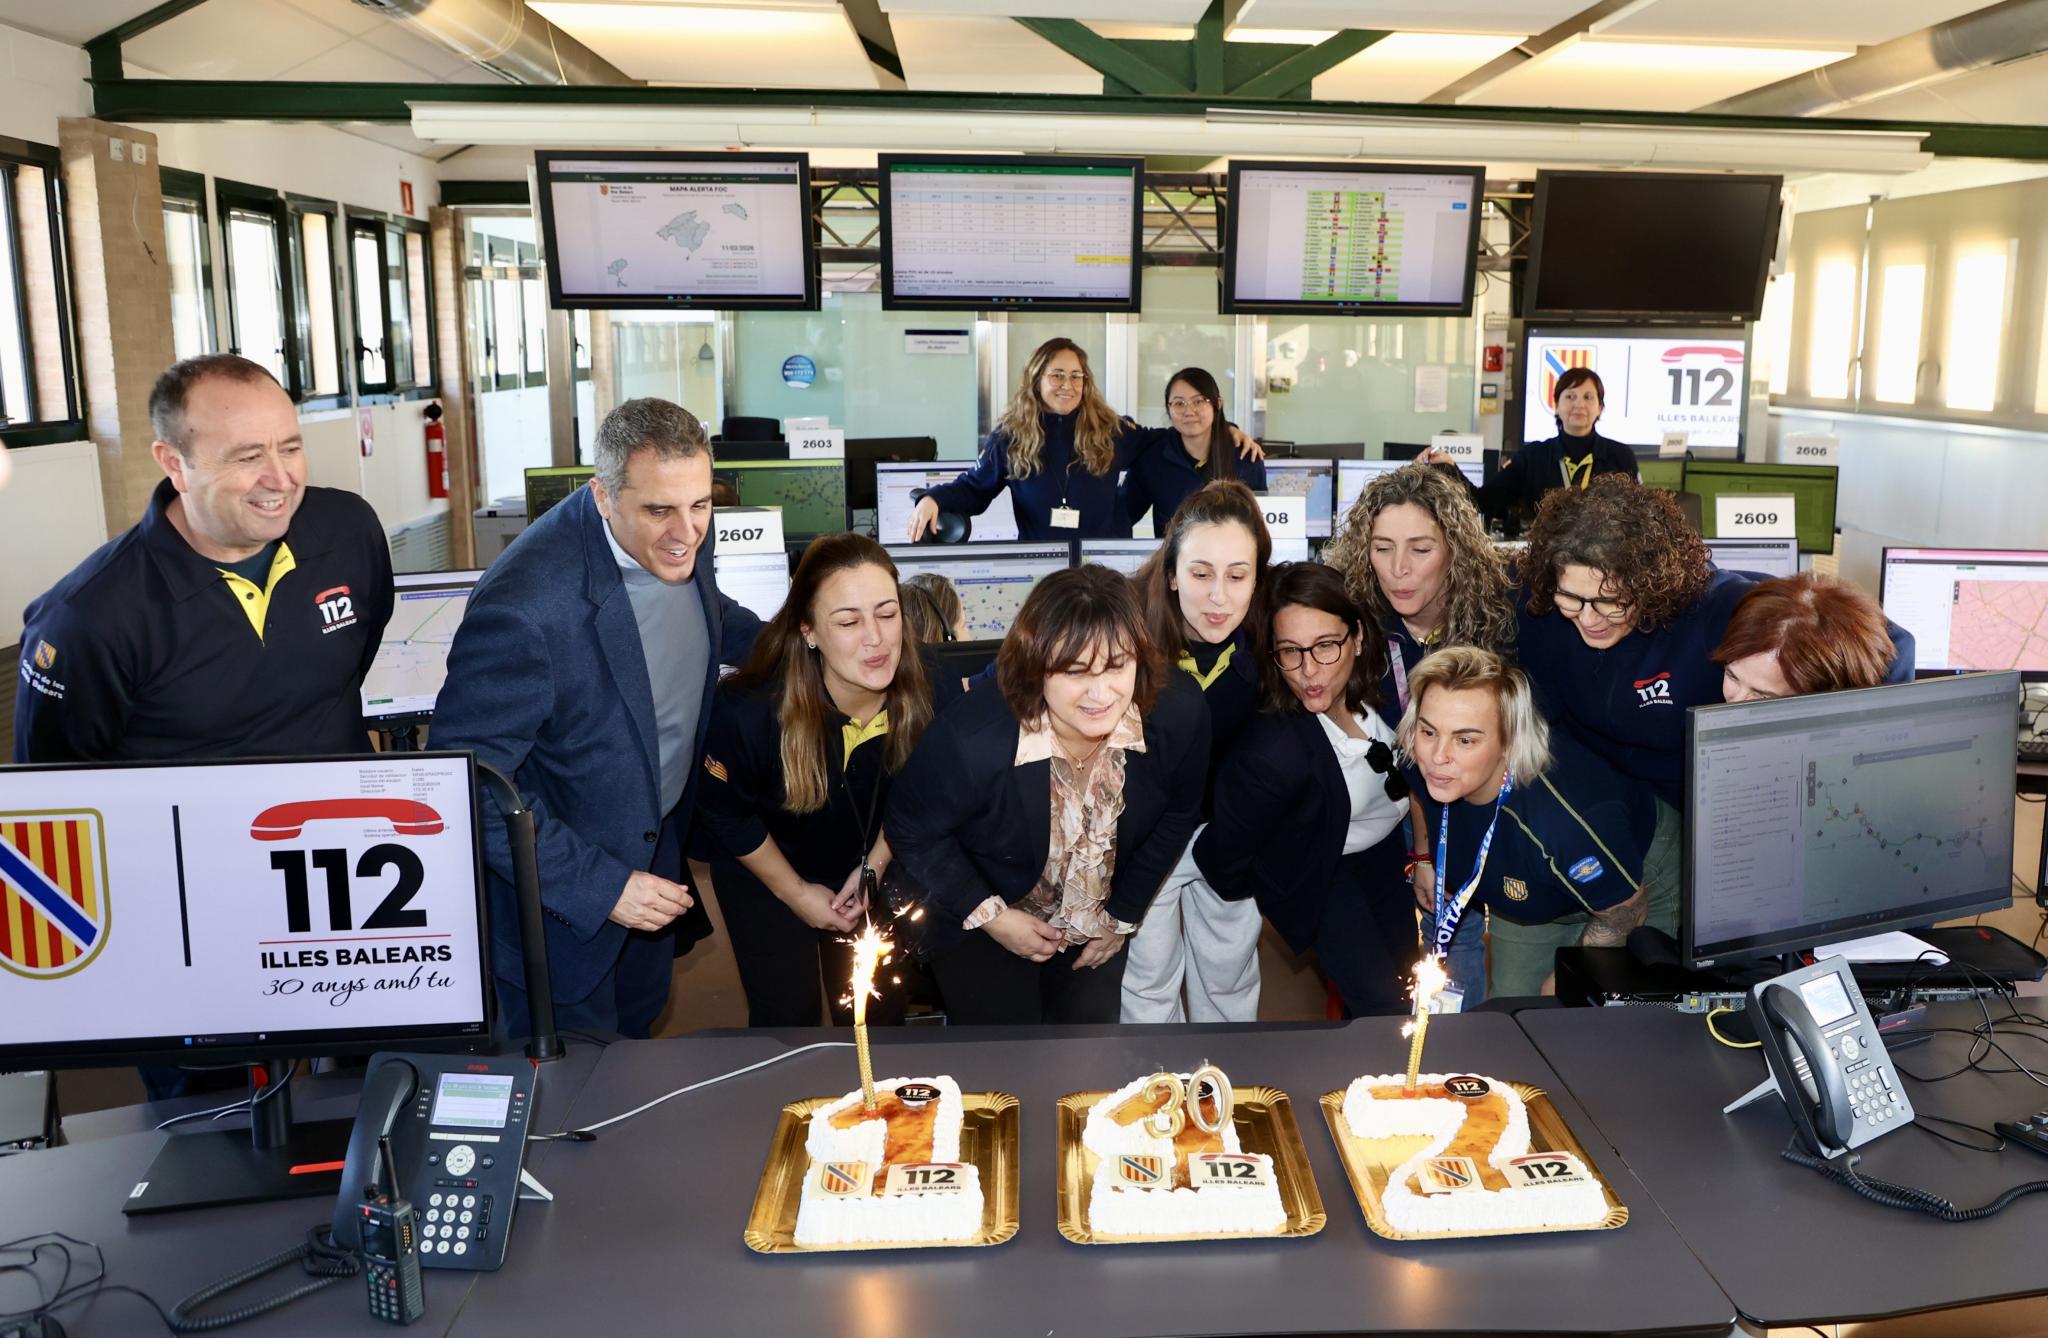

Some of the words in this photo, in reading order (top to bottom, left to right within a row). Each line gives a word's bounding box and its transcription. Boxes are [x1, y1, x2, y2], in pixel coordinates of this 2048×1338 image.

[1668, 368, 1734, 406] 112
[802, 439, 832, 449] 2603
[1796, 446, 1827, 457] 2606
[1734, 512, 1778, 525] 2609
[719, 528, 764, 542] 2607
[318, 597, 355, 624] 112
[1637, 680, 1670, 701] 112
[270, 843, 428, 932] 112
[261, 950, 328, 969] ILLES
[336, 945, 453, 965] BALEARS
[262, 978, 304, 996] 30
[311, 976, 369, 1008] anys
[373, 966, 421, 992] amb
[426, 972, 455, 989] tu
[904, 1088, 931, 1096] 112
[1453, 1082, 1480, 1091] 112
[905, 1169, 955, 1184] 112
[1205, 1162, 1257, 1178] 112
[1518, 1162, 1573, 1179] 112
